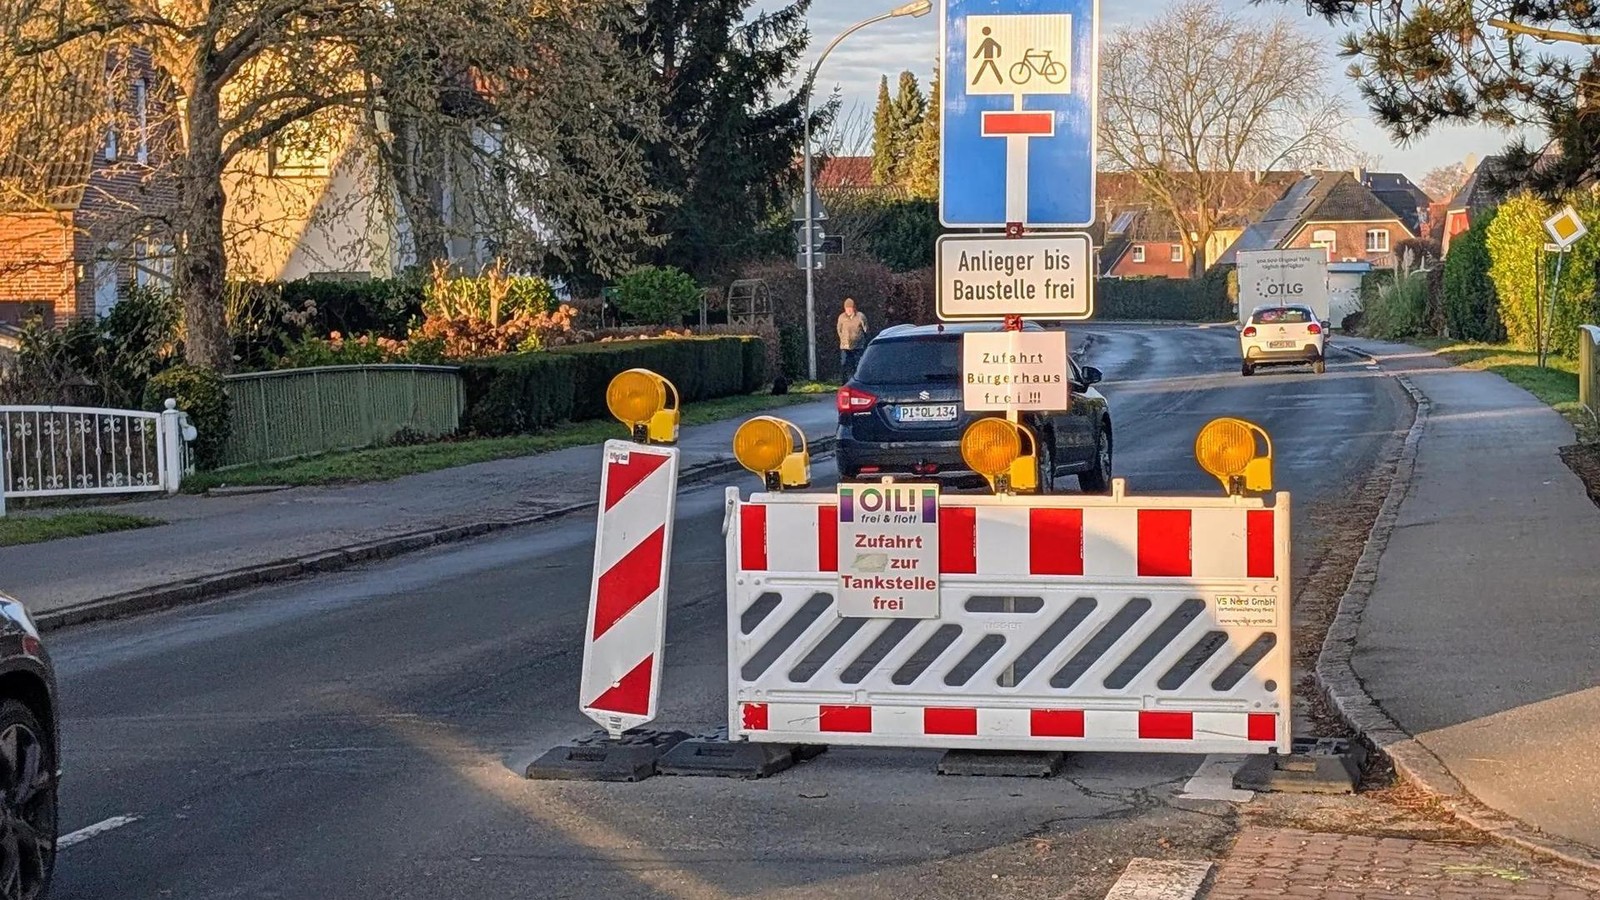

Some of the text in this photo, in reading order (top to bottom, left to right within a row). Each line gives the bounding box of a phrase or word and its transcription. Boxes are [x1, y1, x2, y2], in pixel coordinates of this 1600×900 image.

[958, 249, 1071, 276] Anlieger bis
[953, 278, 1075, 301] Baustelle frei
[1267, 283, 1303, 294] OTLG
[982, 352, 1043, 364] Zufahrt
[967, 373, 1061, 386] Bürgerhaus
[984, 392, 1021, 404] frei
[902, 407, 914, 418] PI
[936, 406, 956, 417] 134
[859, 488, 916, 512] OIL!
[861, 514, 881, 523] frei
[883, 514, 891, 523] &
[854, 534, 923, 549] Zufahrt
[890, 558, 919, 569] zur
[841, 575, 937, 590] Tankstelle
[872, 596, 904, 610] frei
[1229, 597, 1250, 606] Nord
[1251, 597, 1276, 606] GmbH
